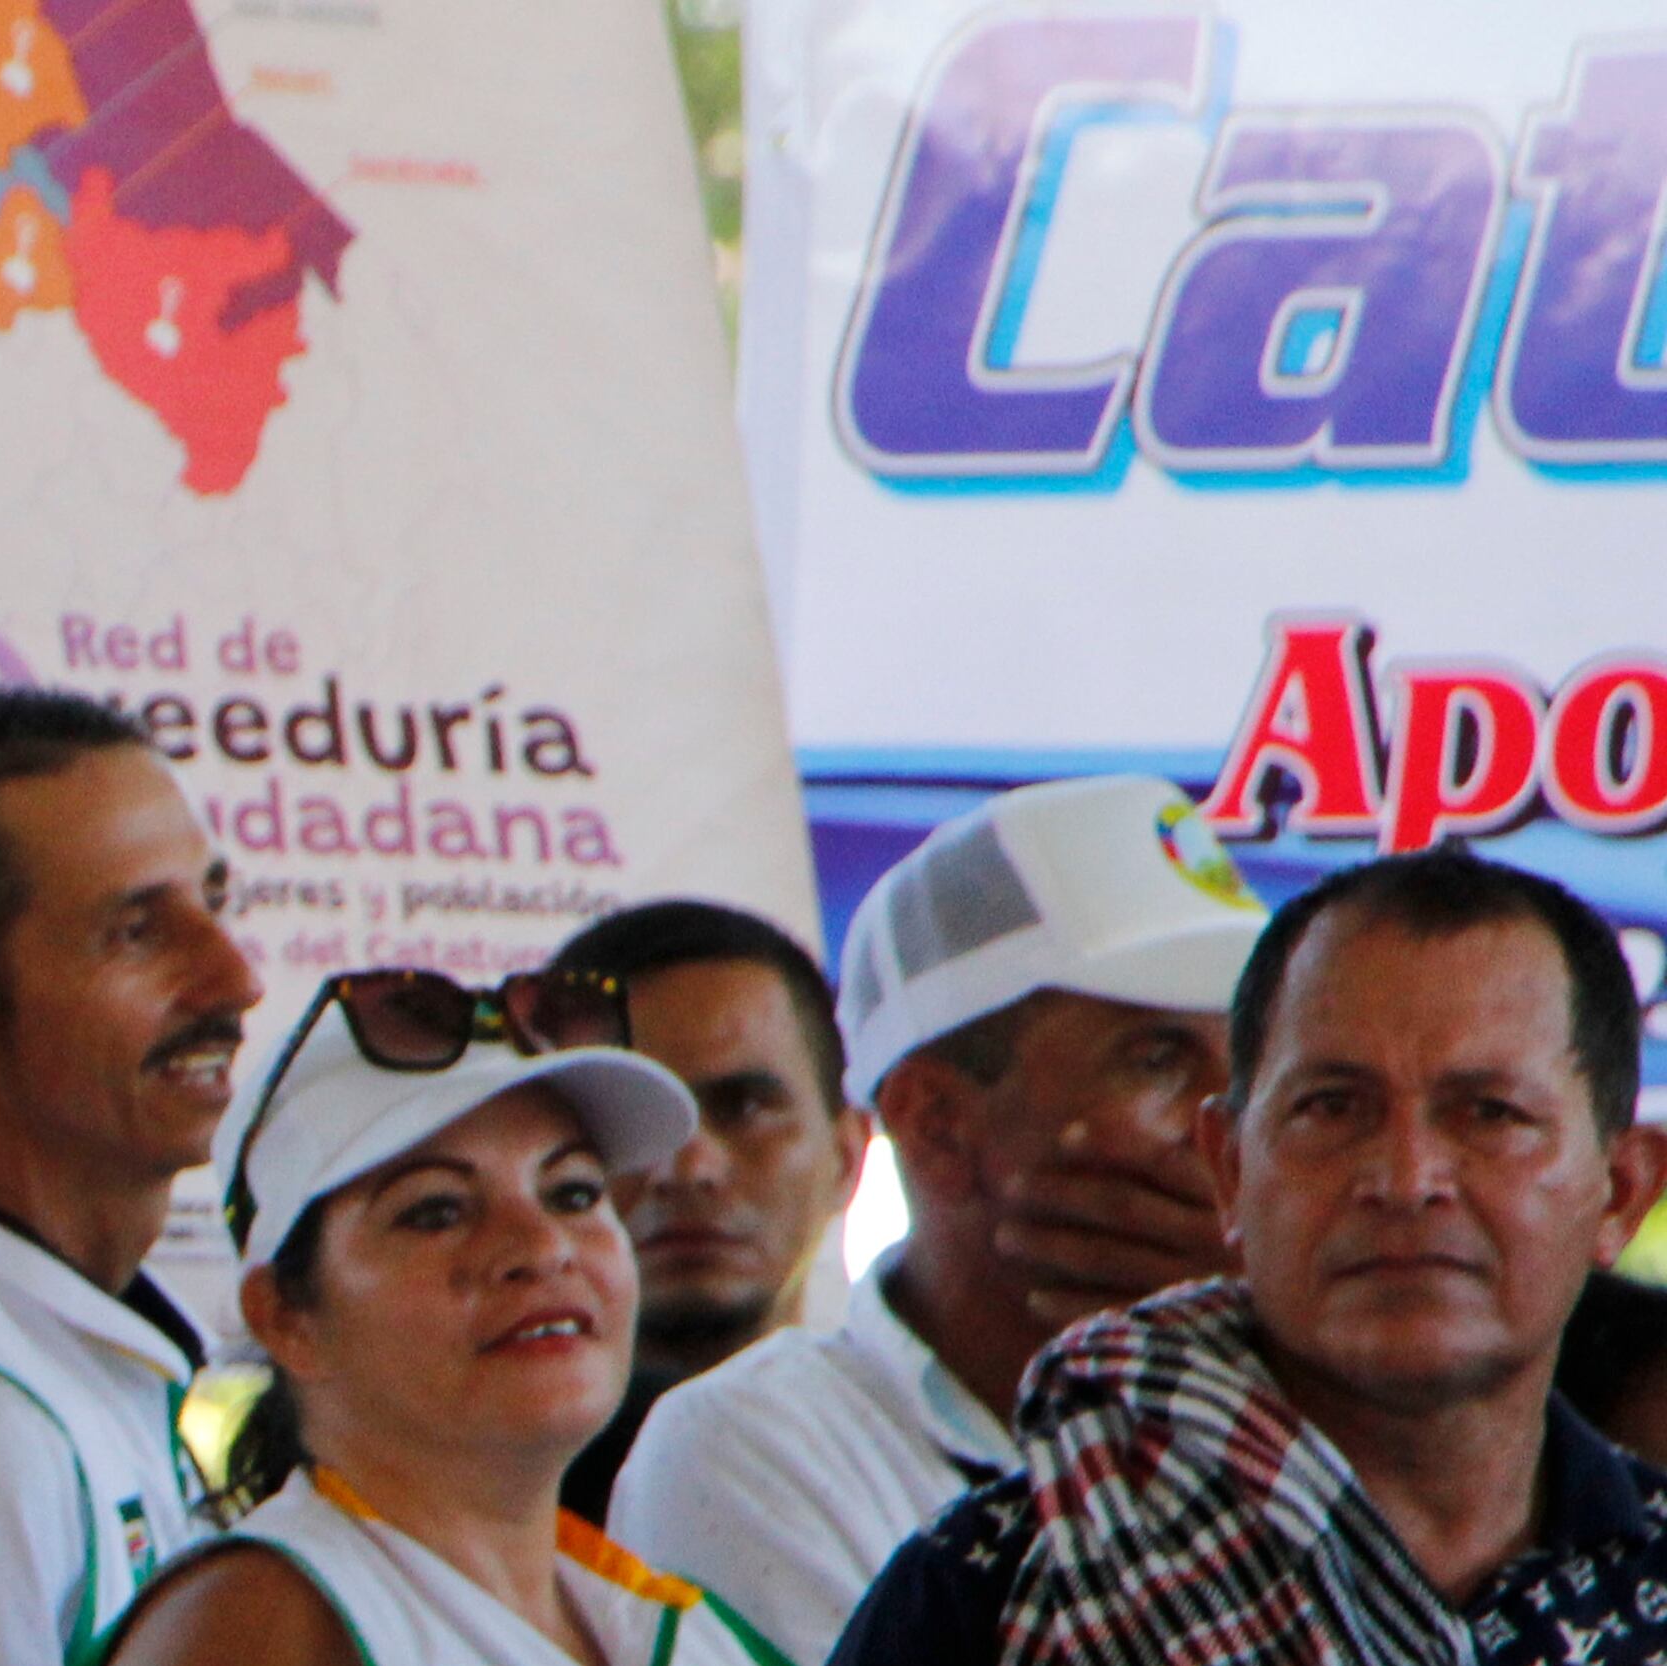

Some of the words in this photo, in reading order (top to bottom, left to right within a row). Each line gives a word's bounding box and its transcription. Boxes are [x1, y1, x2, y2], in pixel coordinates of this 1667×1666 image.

[61, 614, 188, 672] Red
[217, 616, 301, 676] de
[109, 672, 596, 780] eeduría
[207, 776, 624, 868] dadana
[231, 876, 348, 918] jeres
